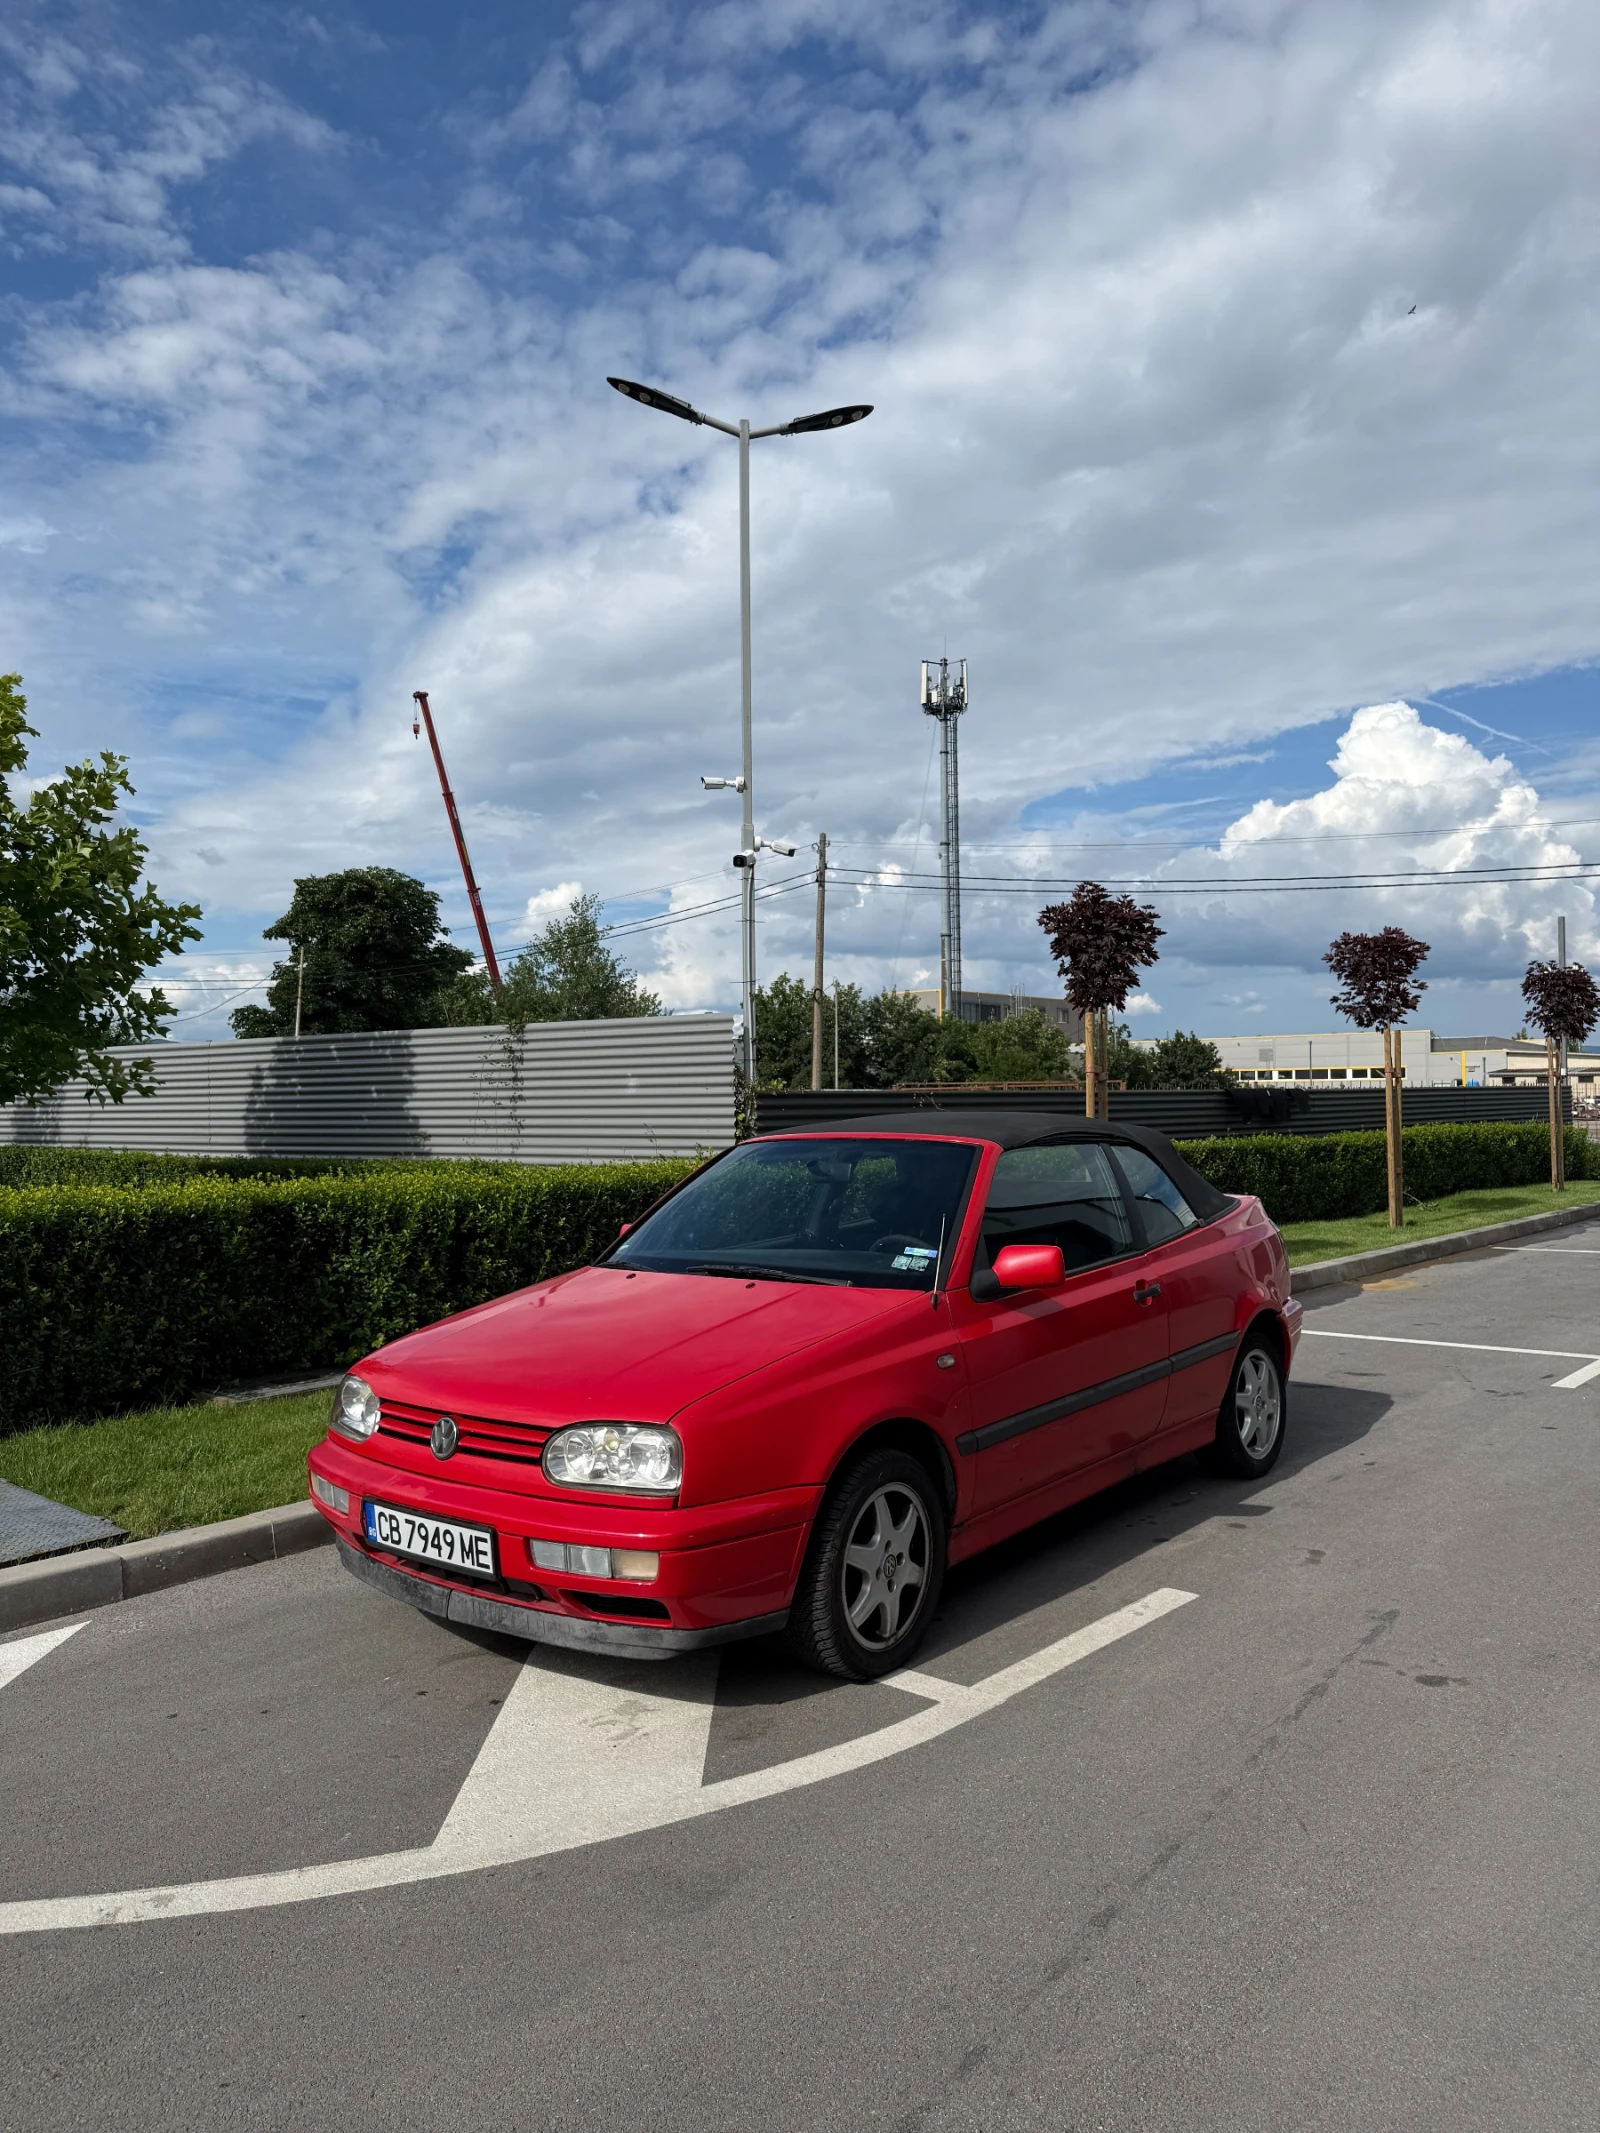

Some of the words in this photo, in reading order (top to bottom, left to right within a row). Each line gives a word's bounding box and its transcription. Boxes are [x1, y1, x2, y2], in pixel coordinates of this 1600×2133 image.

[368, 1526, 377, 1537] BG
[377, 1511, 402, 1546] CB
[404, 1518, 455, 1560] 7949
[459, 1531, 491, 1570] ME
